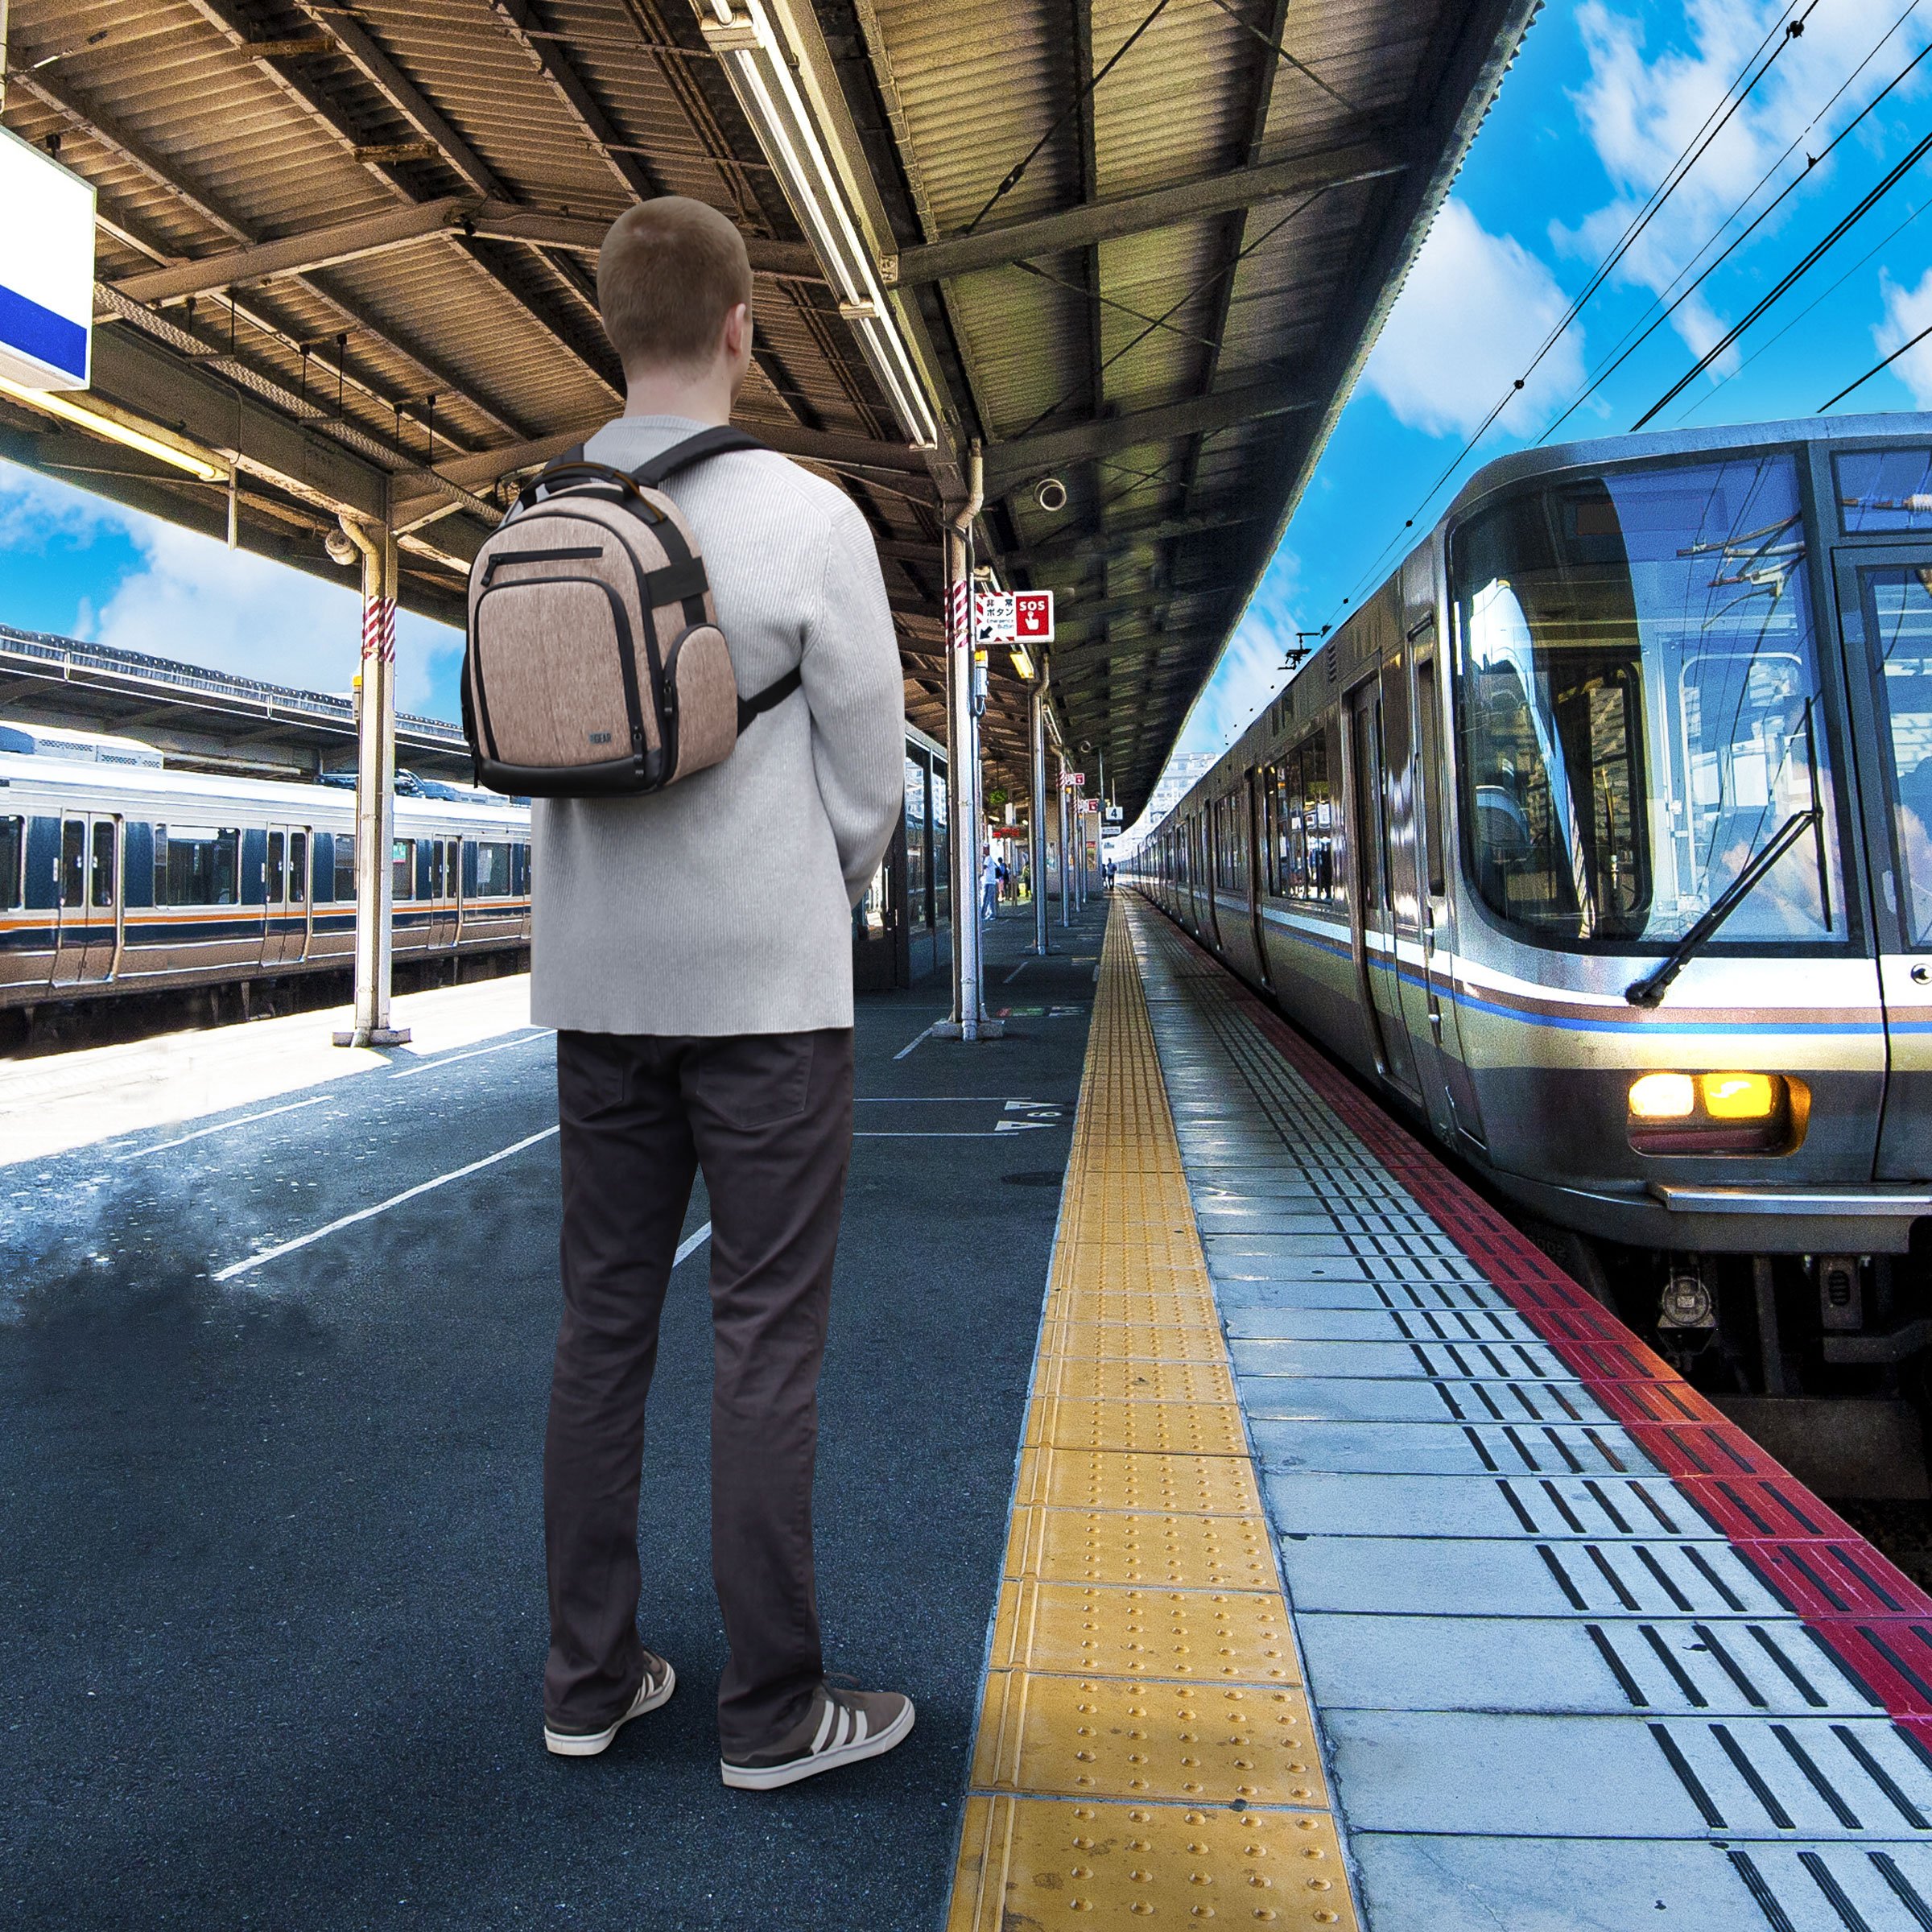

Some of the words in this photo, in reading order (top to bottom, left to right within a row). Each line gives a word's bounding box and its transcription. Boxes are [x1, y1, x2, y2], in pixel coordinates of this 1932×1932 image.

[1019, 601, 1045, 611] SOS
[987, 609, 1013, 617] ボタン
[1111, 808, 1117, 818] 4
